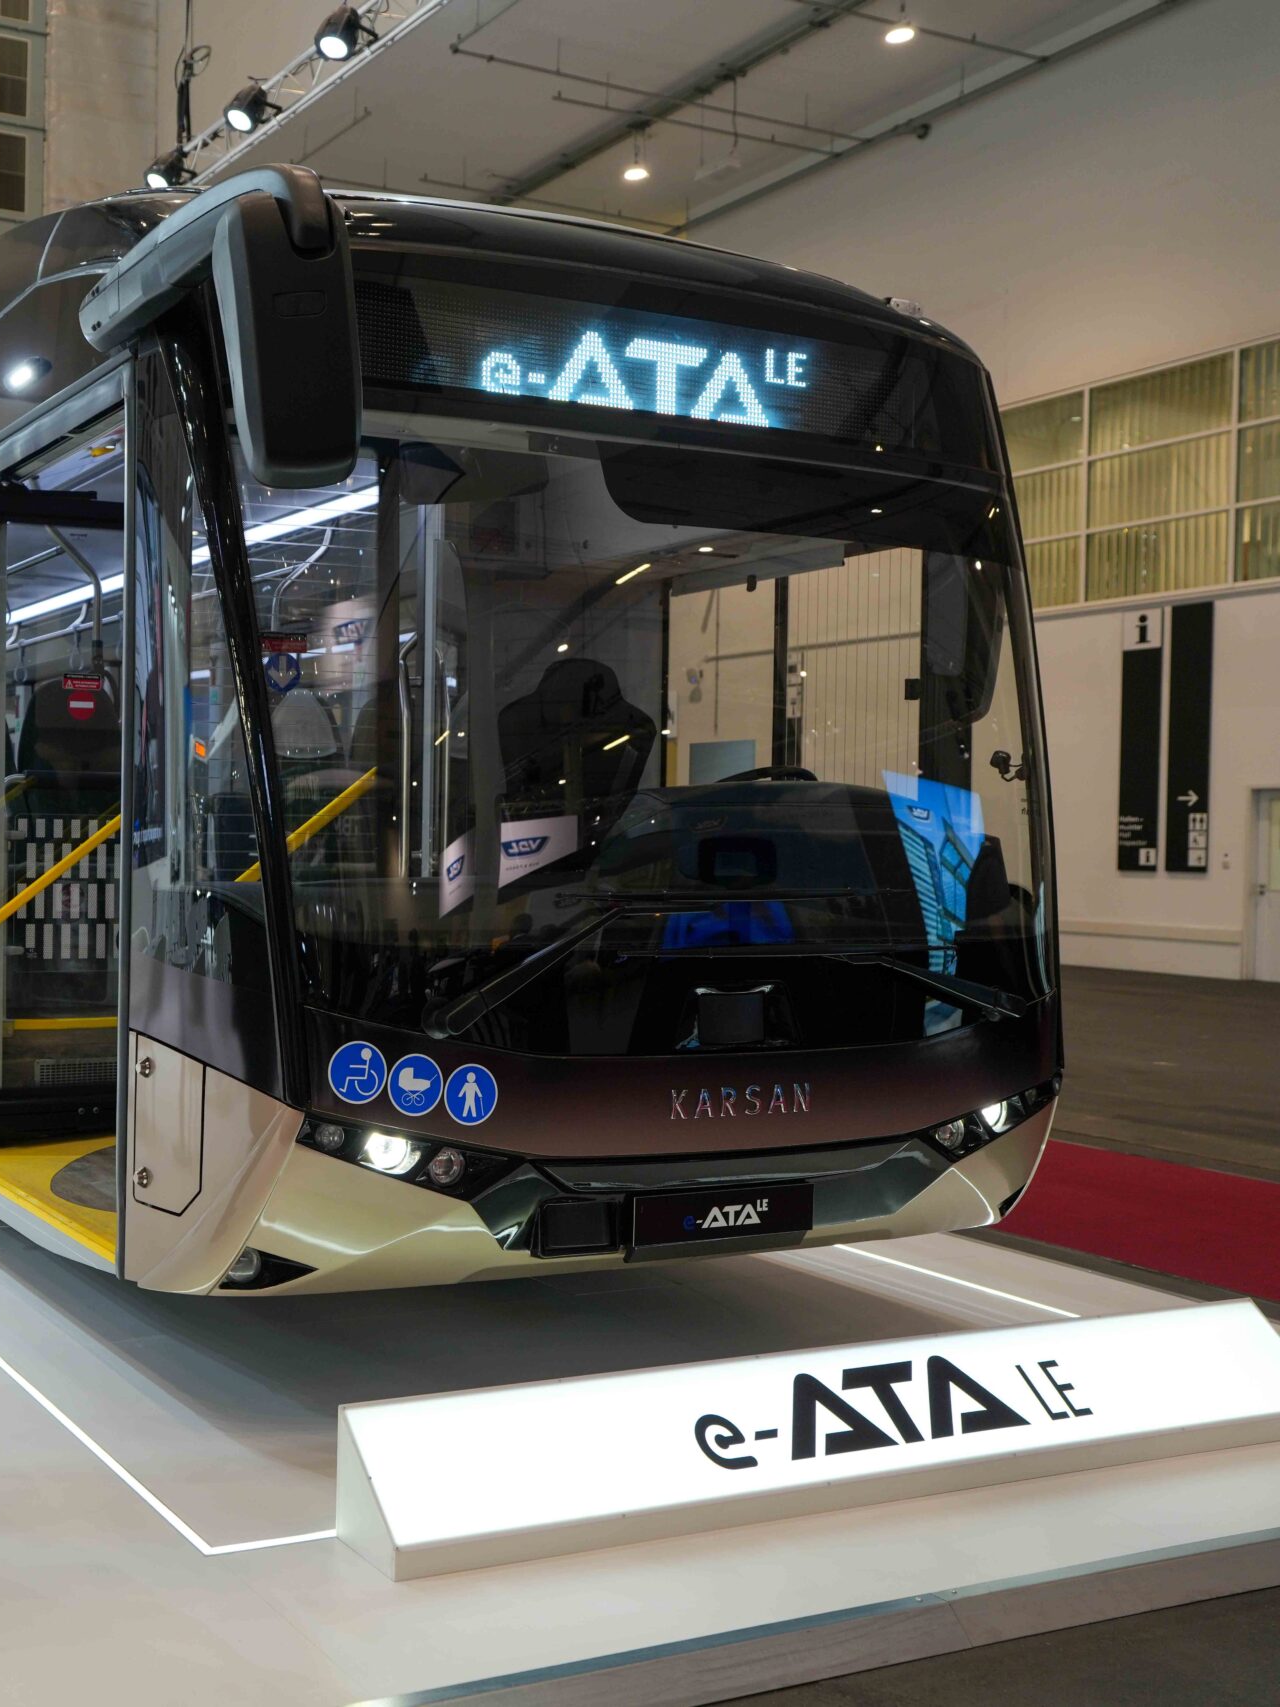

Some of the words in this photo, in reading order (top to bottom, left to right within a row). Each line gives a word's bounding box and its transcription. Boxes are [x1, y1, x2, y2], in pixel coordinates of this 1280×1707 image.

[482, 331, 769, 428] e-ATA
[765, 348, 807, 388] LE
[671, 1082, 810, 1119] KARSAN
[683, 1203, 761, 1230] e-ATA
[757, 1199, 769, 1212] LE
[694, 1355, 1031, 1470] e-ATA
[1015, 1359, 1093, 1420] LE
